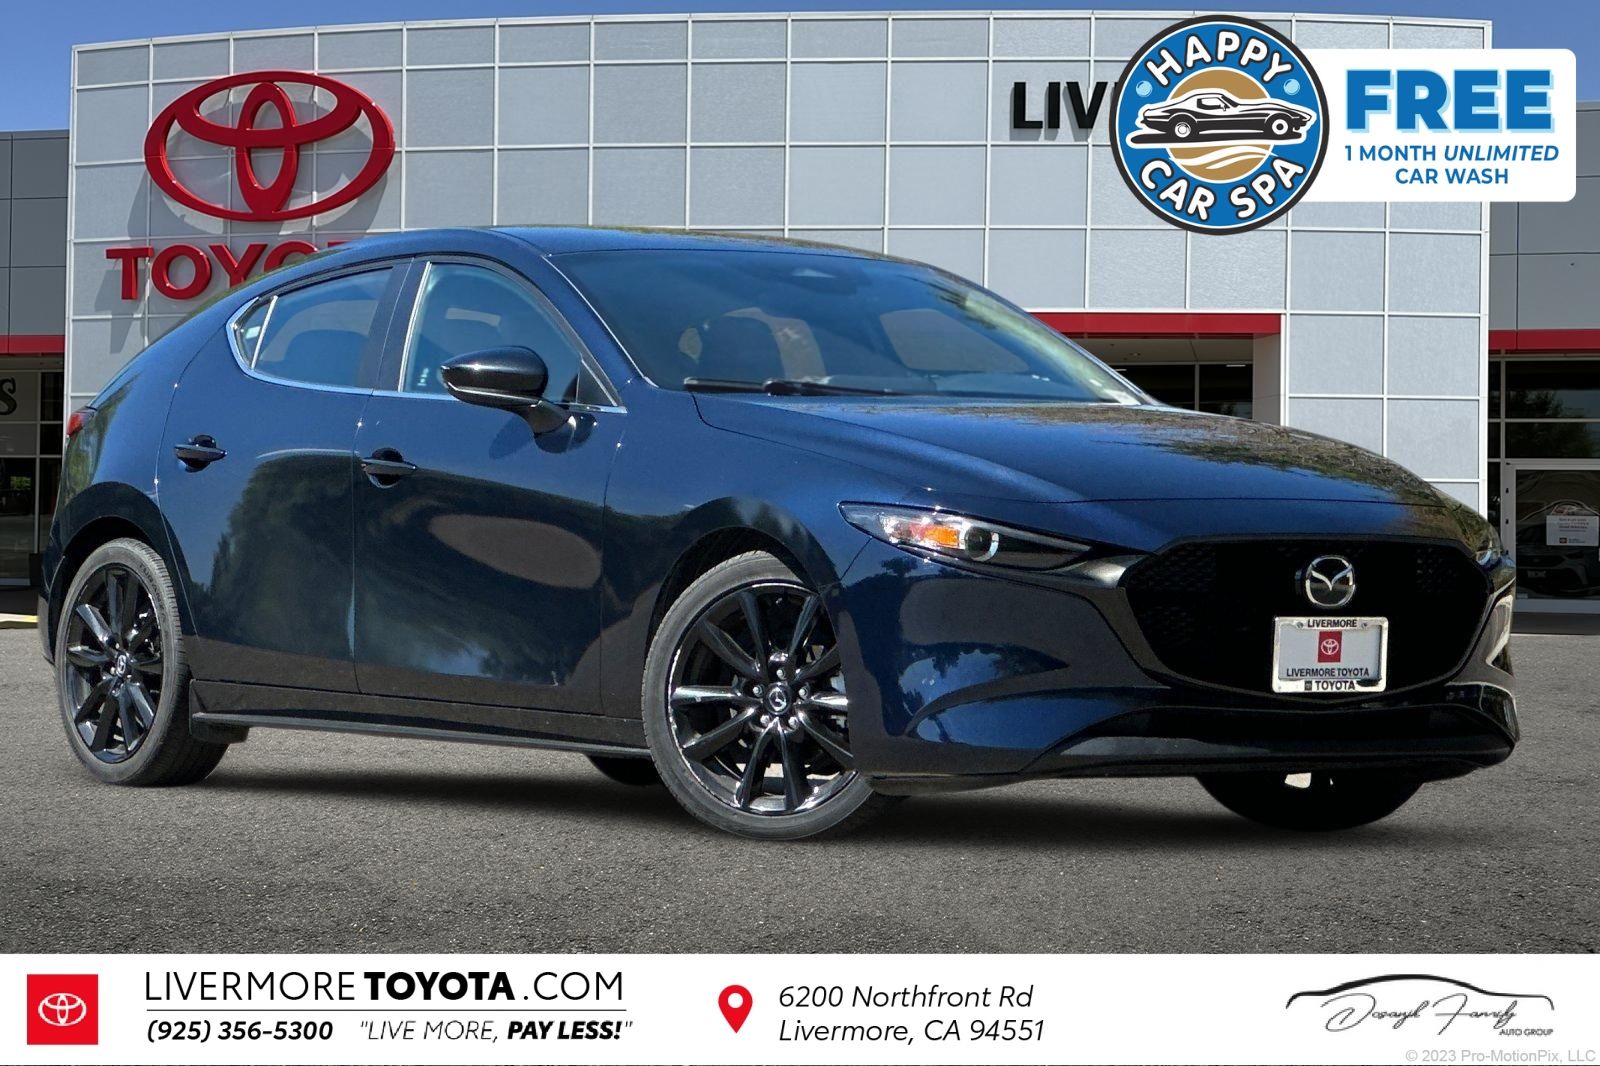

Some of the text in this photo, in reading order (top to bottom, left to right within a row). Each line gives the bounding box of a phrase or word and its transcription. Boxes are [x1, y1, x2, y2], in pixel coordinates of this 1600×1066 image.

[1013, 82, 1118, 129] LIV
[1307, 619, 1357, 628] LIVERMORE
[1286, 667, 1370, 677] LIVERMORE TOYOTA
[1315, 680, 1356, 691] TOYOTA
